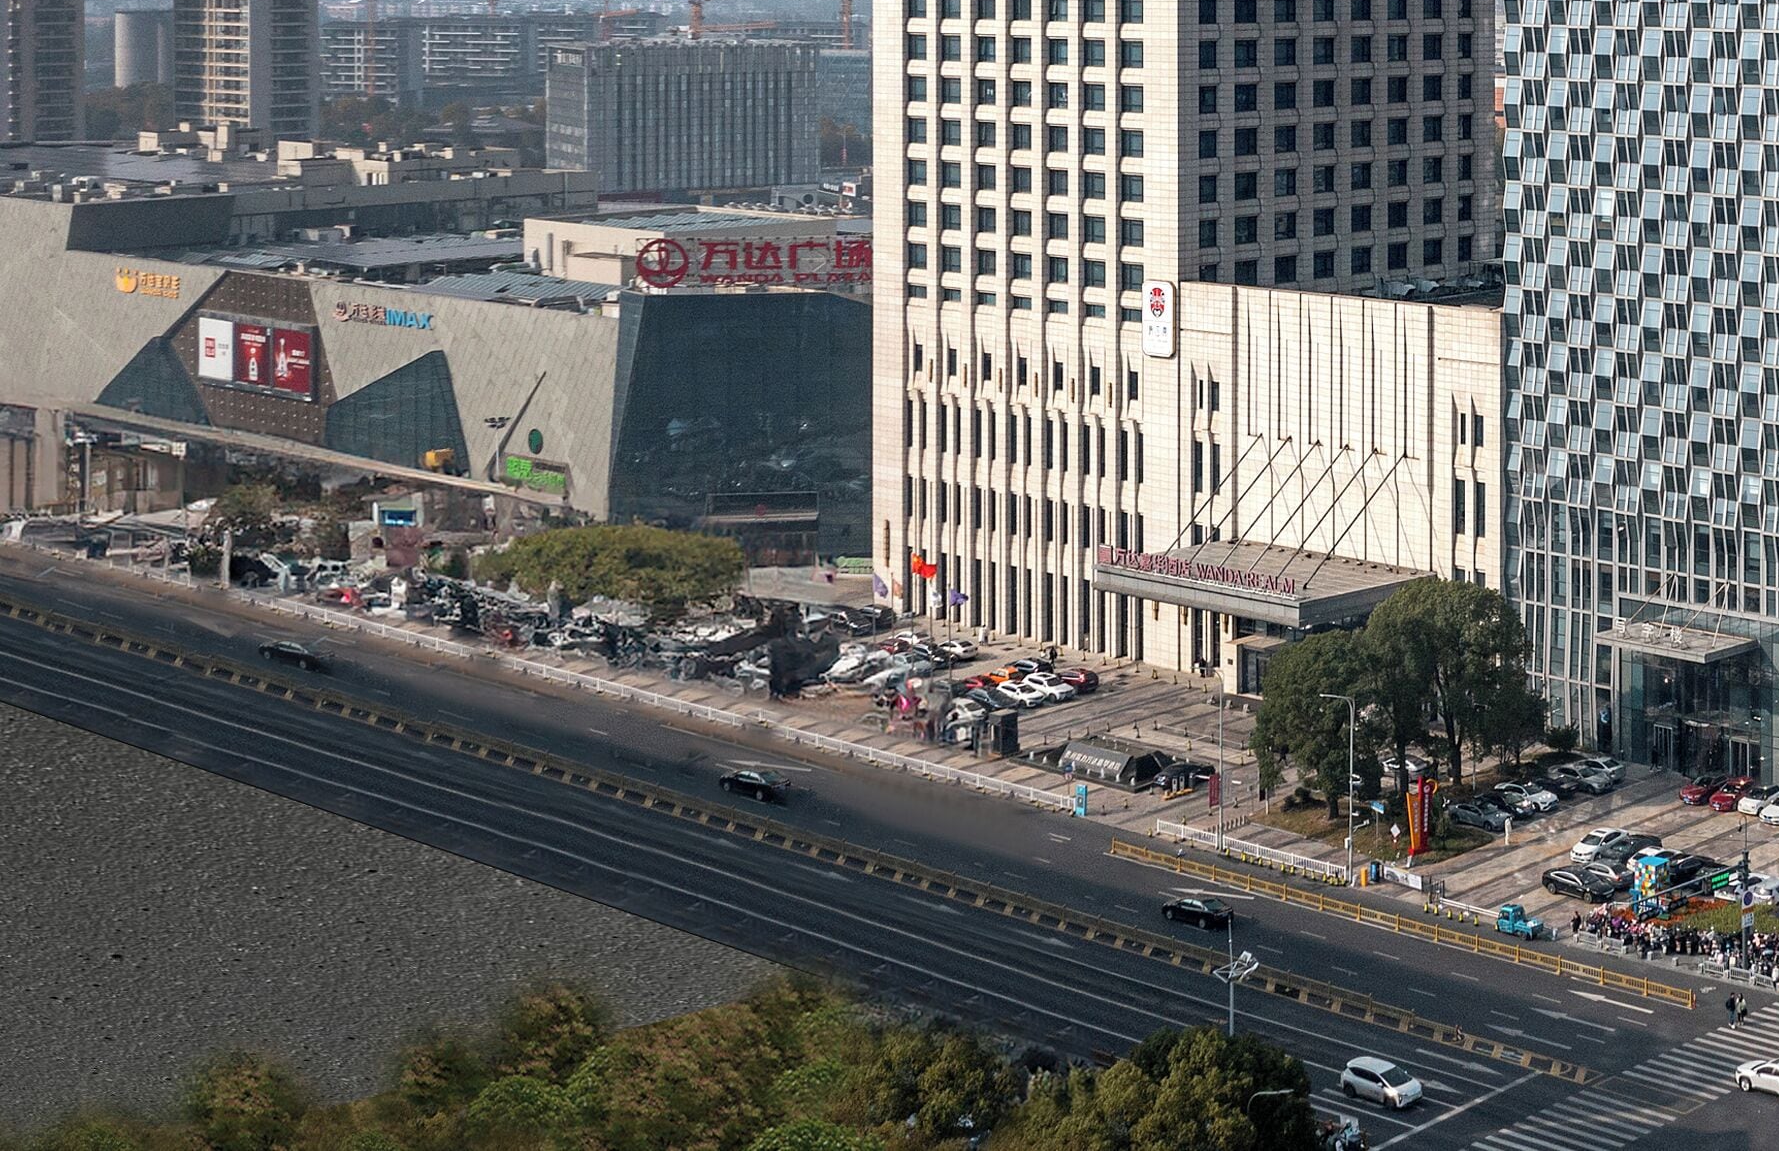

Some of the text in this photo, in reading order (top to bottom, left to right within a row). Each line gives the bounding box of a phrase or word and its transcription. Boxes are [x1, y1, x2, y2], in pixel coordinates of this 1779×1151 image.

[699, 240, 873, 270] 万达广场
[699, 272, 872, 284] WANDA PLAZA
[385, 307, 433, 330] IMAX
[1114, 547, 1192, 577] 万达嘉华酒店
[1196, 563, 1296, 594] WANDA REALM
